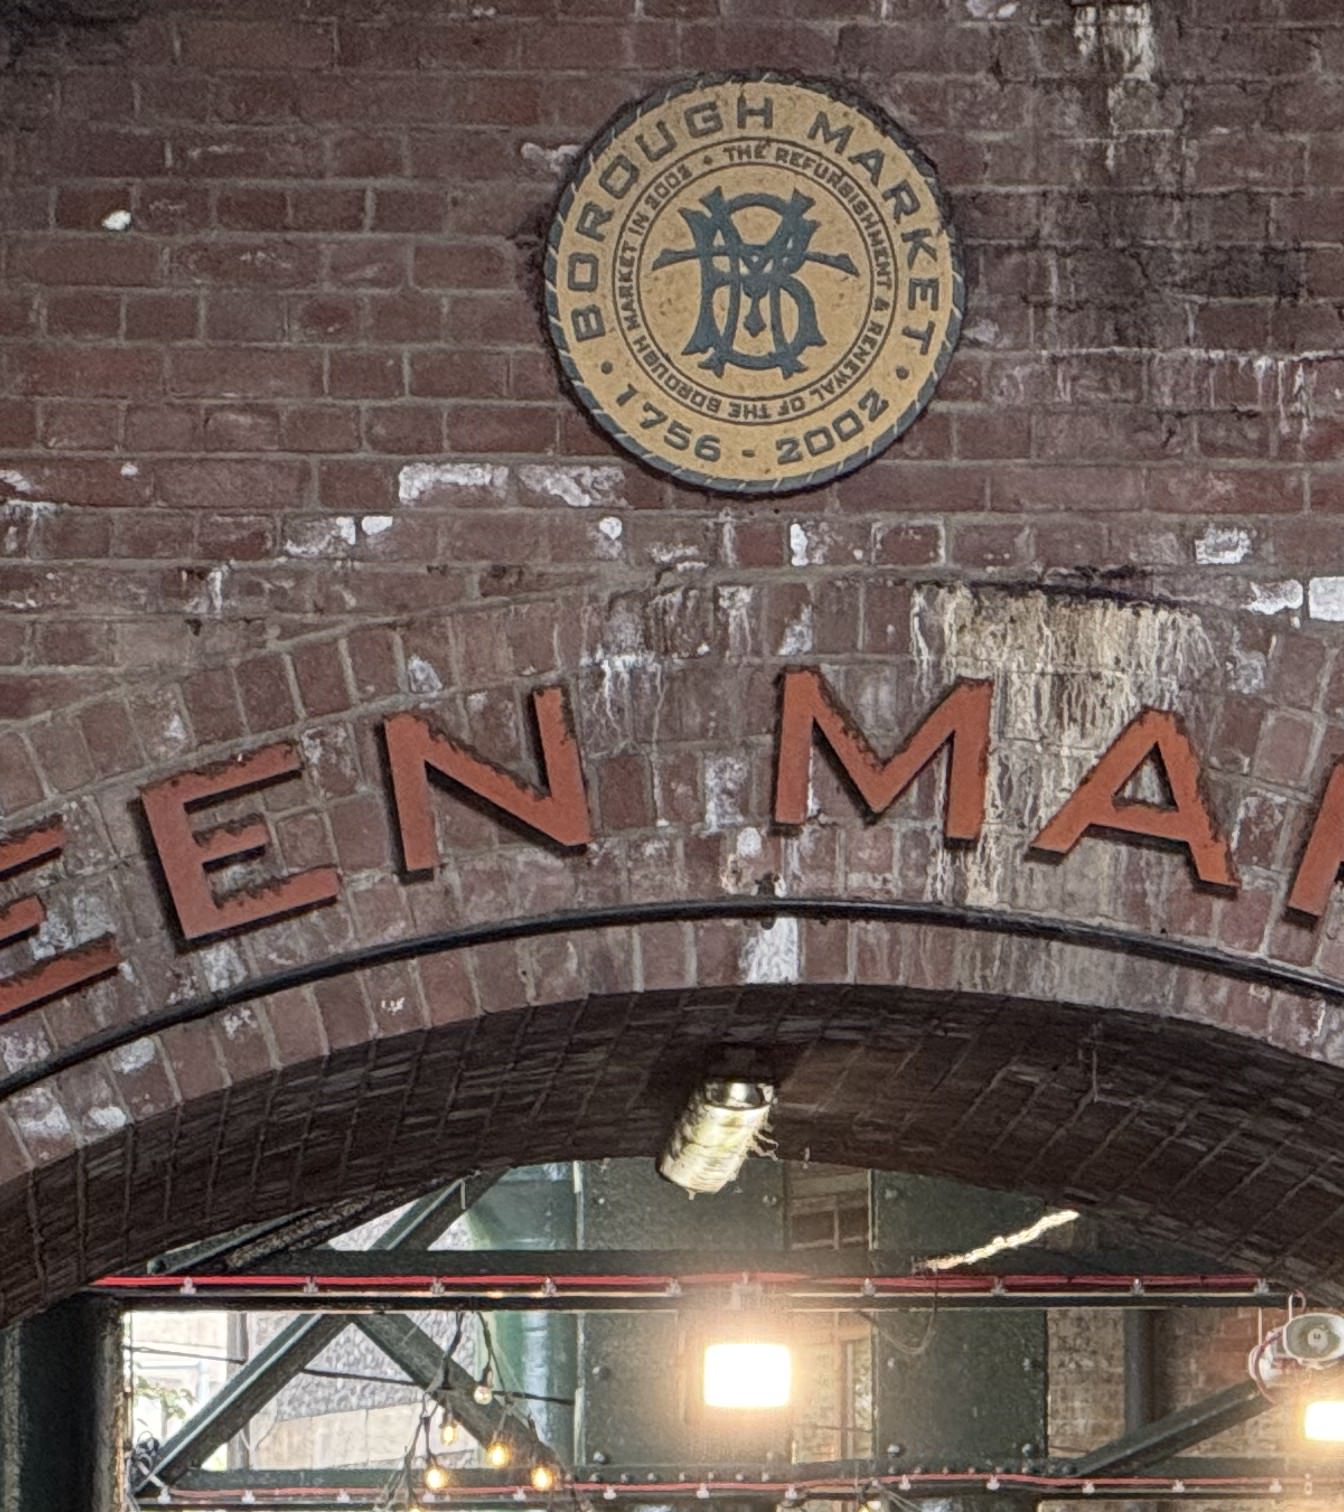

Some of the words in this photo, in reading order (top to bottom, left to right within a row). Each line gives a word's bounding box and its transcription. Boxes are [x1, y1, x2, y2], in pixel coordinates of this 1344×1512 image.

[643, 163, 693, 210] 2002
[723, 143, 769, 163] THE
[567, 95, 774, 342] BOROUGH
[806, 110, 940, 356] MARKET
[628, 211, 650, 236] IN
[775, 147, 892, 290] REFURBISHMENT
[617, 240, 641, 331] MARKET
[633, 334, 722, 413] BOROUGH
[808, 320, 885, 401] RENEWAL
[616, 382, 722, 463] 1756
[775, 386, 891, 465] 2002
[727, 401, 772, 419] THE
[778, 395, 806, 416] OF
